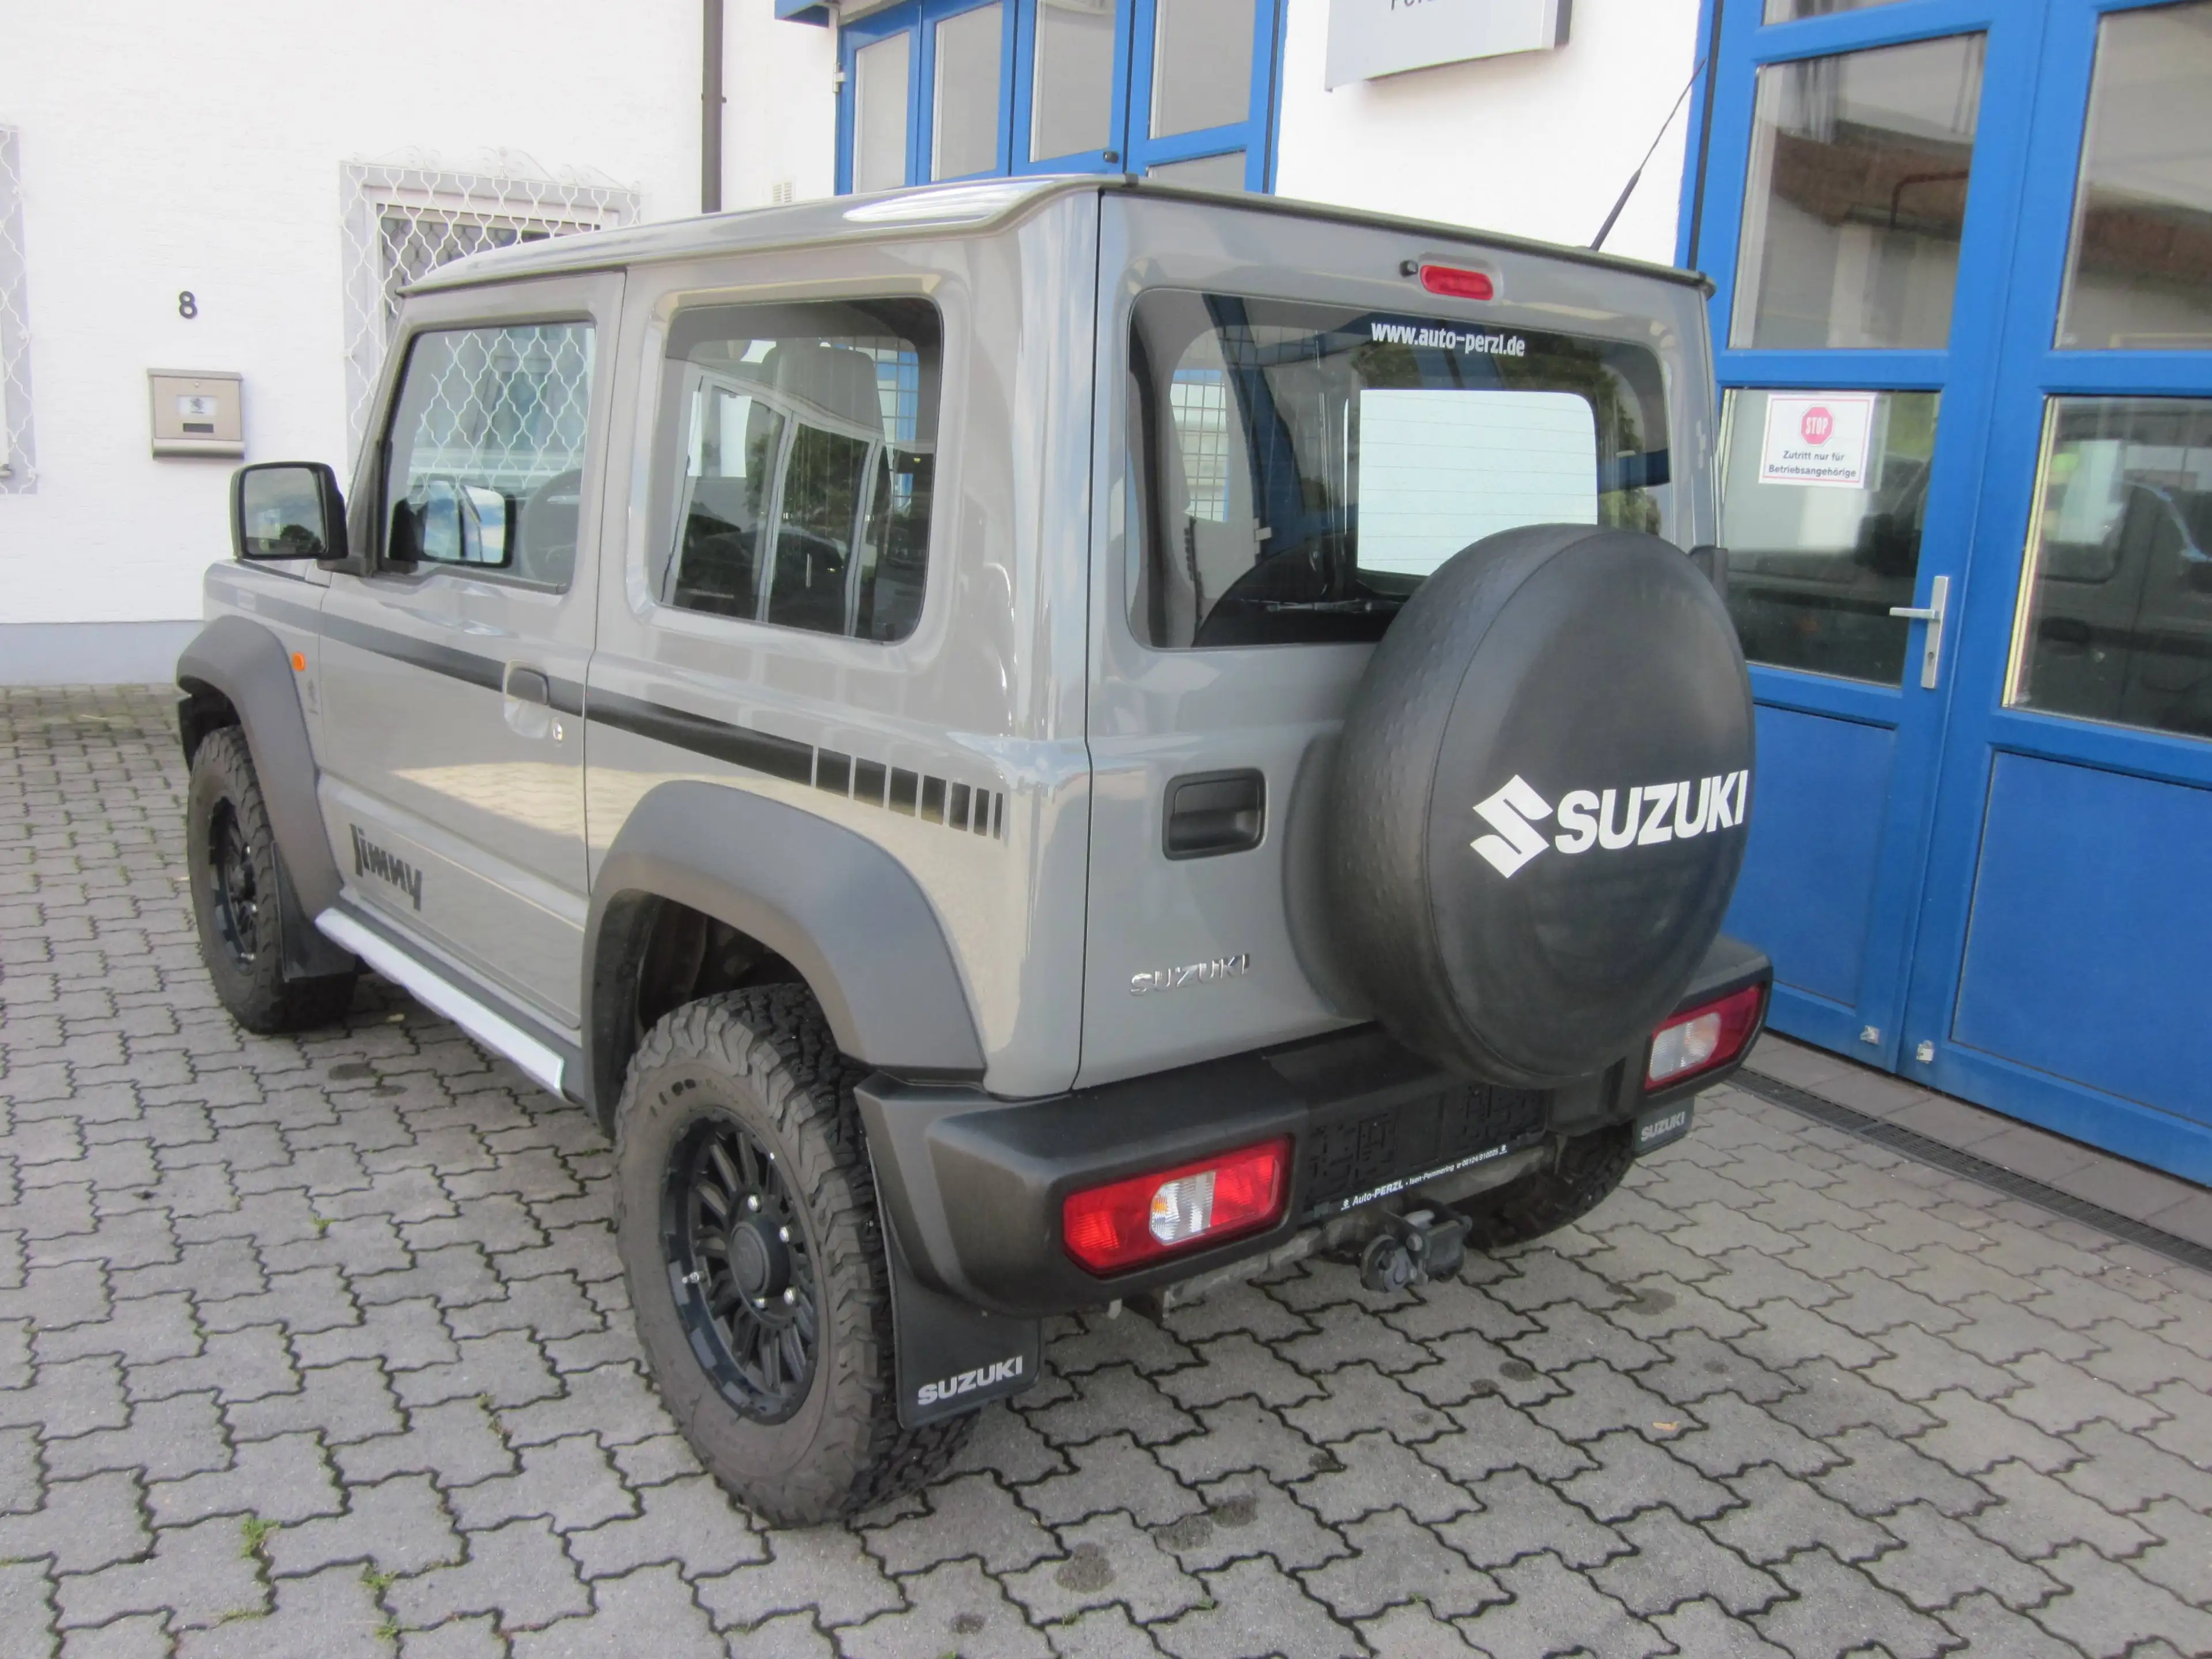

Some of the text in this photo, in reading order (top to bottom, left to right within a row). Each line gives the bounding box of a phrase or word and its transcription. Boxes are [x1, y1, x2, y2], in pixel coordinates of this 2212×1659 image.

[179, 290, 198, 319] 8
[1371, 322, 1525, 357] www.auto-perzl.de
[1805, 416, 1828, 435] STOP
[1783, 450, 1811, 460] Zutritt
[1832, 452, 1845, 461] für
[1768, 464, 1857, 478] Betriebsangehörige
[1555, 770, 1749, 854] SUZUKI
[1130, 953, 1250, 997] SUZUKI
[1641, 1111, 1685, 1142] SUZUKI
[1352, 1179, 1404, 1207] Auto-PERZL
[917, 1355, 1023, 1406] SUZUKI
